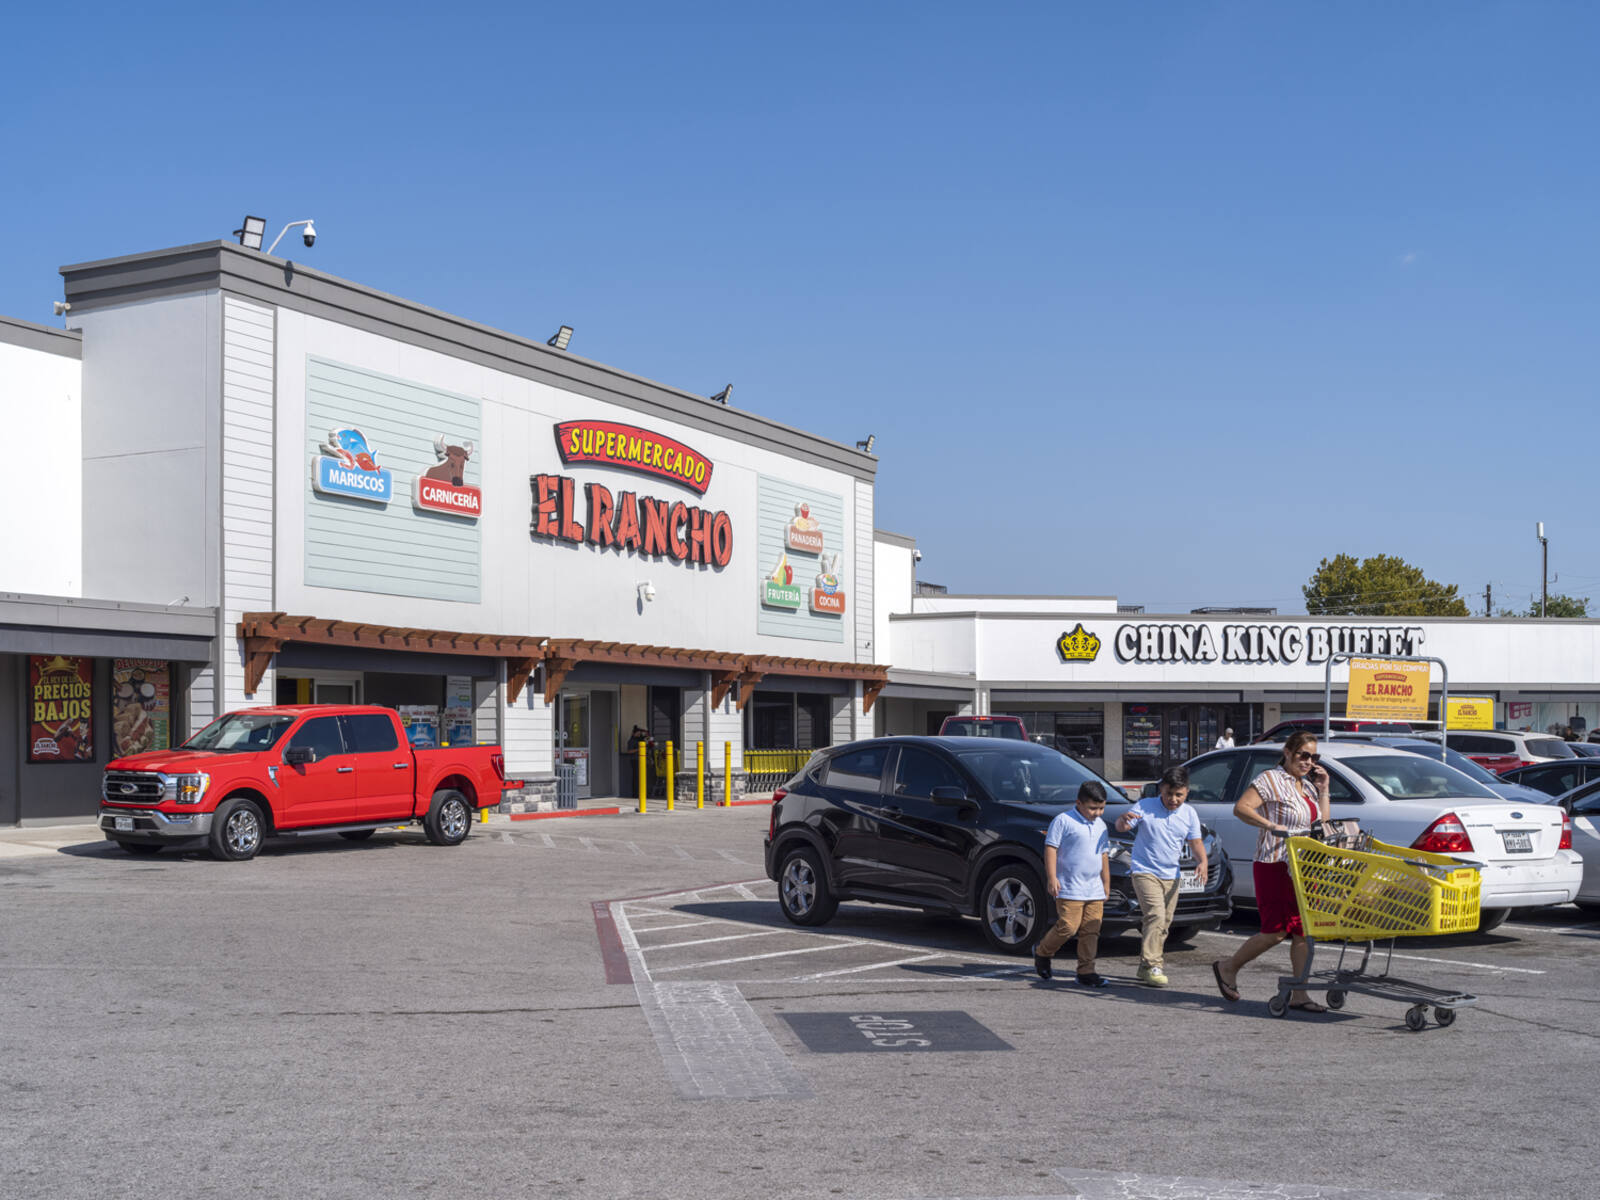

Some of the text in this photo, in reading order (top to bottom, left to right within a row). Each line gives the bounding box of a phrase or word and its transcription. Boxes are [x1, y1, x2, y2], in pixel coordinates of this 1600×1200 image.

[568, 427, 706, 484] SUPERMERCADO
[329, 468, 385, 493] MARISCOS
[422, 486, 479, 510] CARNICERÍA
[533, 474, 733, 567] EL RANCHO
[767, 588, 800, 603] FRUTERÍA
[819, 595, 840, 608] COCINA
[1116, 624, 1425, 662] CHINA KING BUFFET
[34, 682, 91, 700] PRECIOS
[1366, 683, 1413, 697] EL RANCHO
[34, 699, 91, 722] BAJOS
[849, 1014, 932, 1047] STOP
